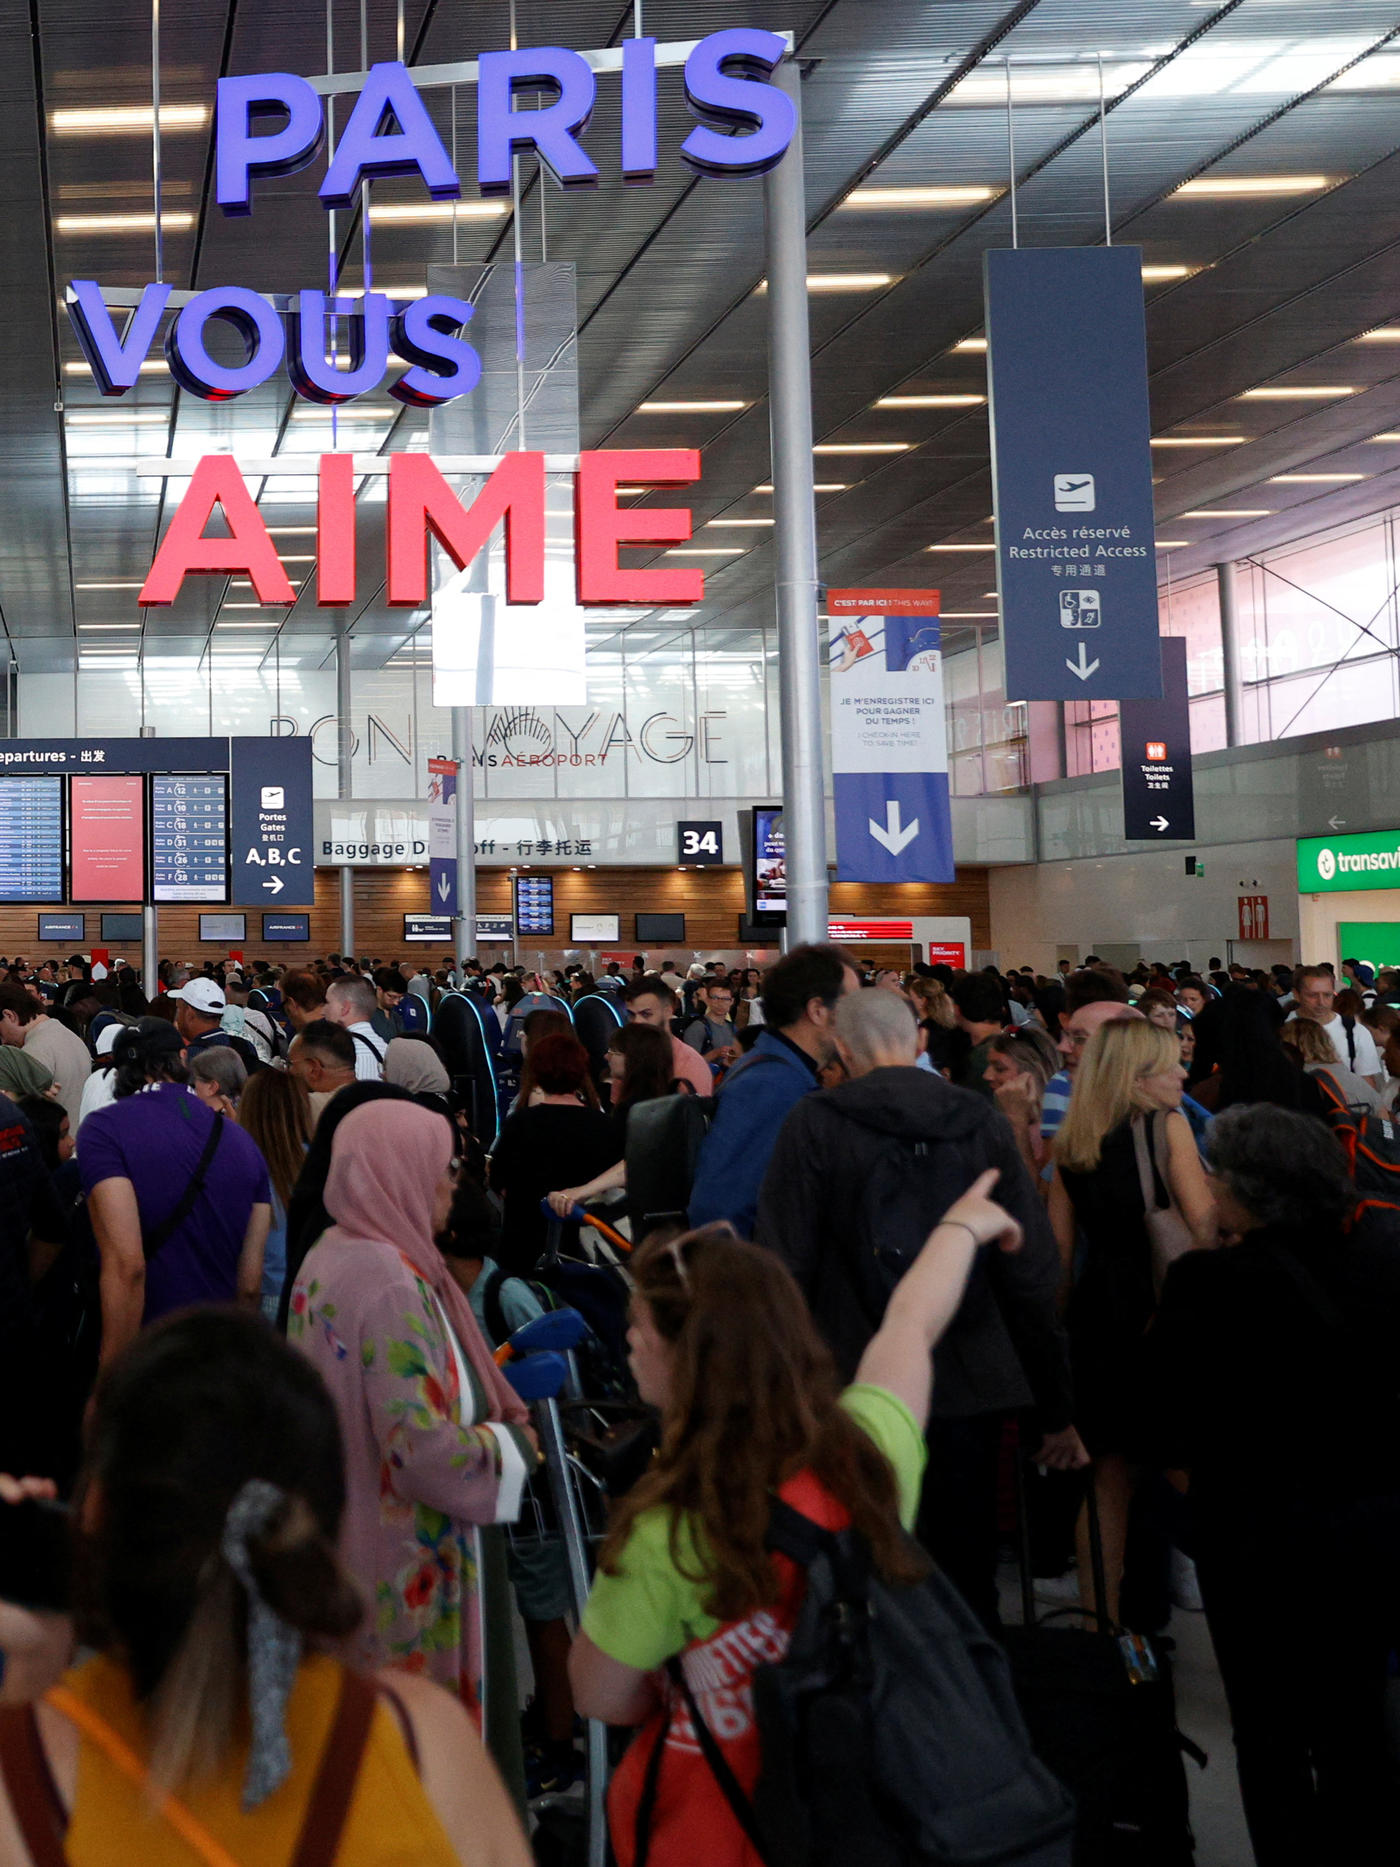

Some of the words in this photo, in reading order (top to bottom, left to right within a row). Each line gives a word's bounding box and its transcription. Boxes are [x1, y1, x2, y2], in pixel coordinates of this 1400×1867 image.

[217, 28, 798, 216] PARIS
[67, 280, 482, 407] VOUS
[138, 449, 704, 607] AIME
[1023, 527, 1067, 540] Accès
[1073, 525, 1131, 538] réservé
[1009, 546, 1090, 559] Restricted
[1095, 545, 1148, 557] Access
[1051, 564, 1106, 577] 专用通道
[858, 599, 875, 607] PAR
[876, 599, 887, 607] ICI
[894, 599, 911, 607] THIS
[840, 697, 851, 705] JE
[854, 697, 920, 705] M'ENREGISTRE
[922, 697, 935, 705] ICI
[856, 707, 881, 715] POUR
[883, 707, 920, 715] GAGNER
[865, 717, 878, 725] DU
[881, 717, 911, 725] TEMPS
[901, 731, 921, 739] HERE
[80, 749, 106, 764] 出发
[1140, 765, 1174, 773] Toilettes
[1145, 774, 1170, 782] Toilets
[258, 813, 287, 822] Portes
[260, 823, 286, 832] Gates
[322, 839, 405, 858] Baggage
[517, 838, 593, 857] 行李托运
[683, 831, 718, 854] 34
[245, 848, 302, 867] A,B,C
